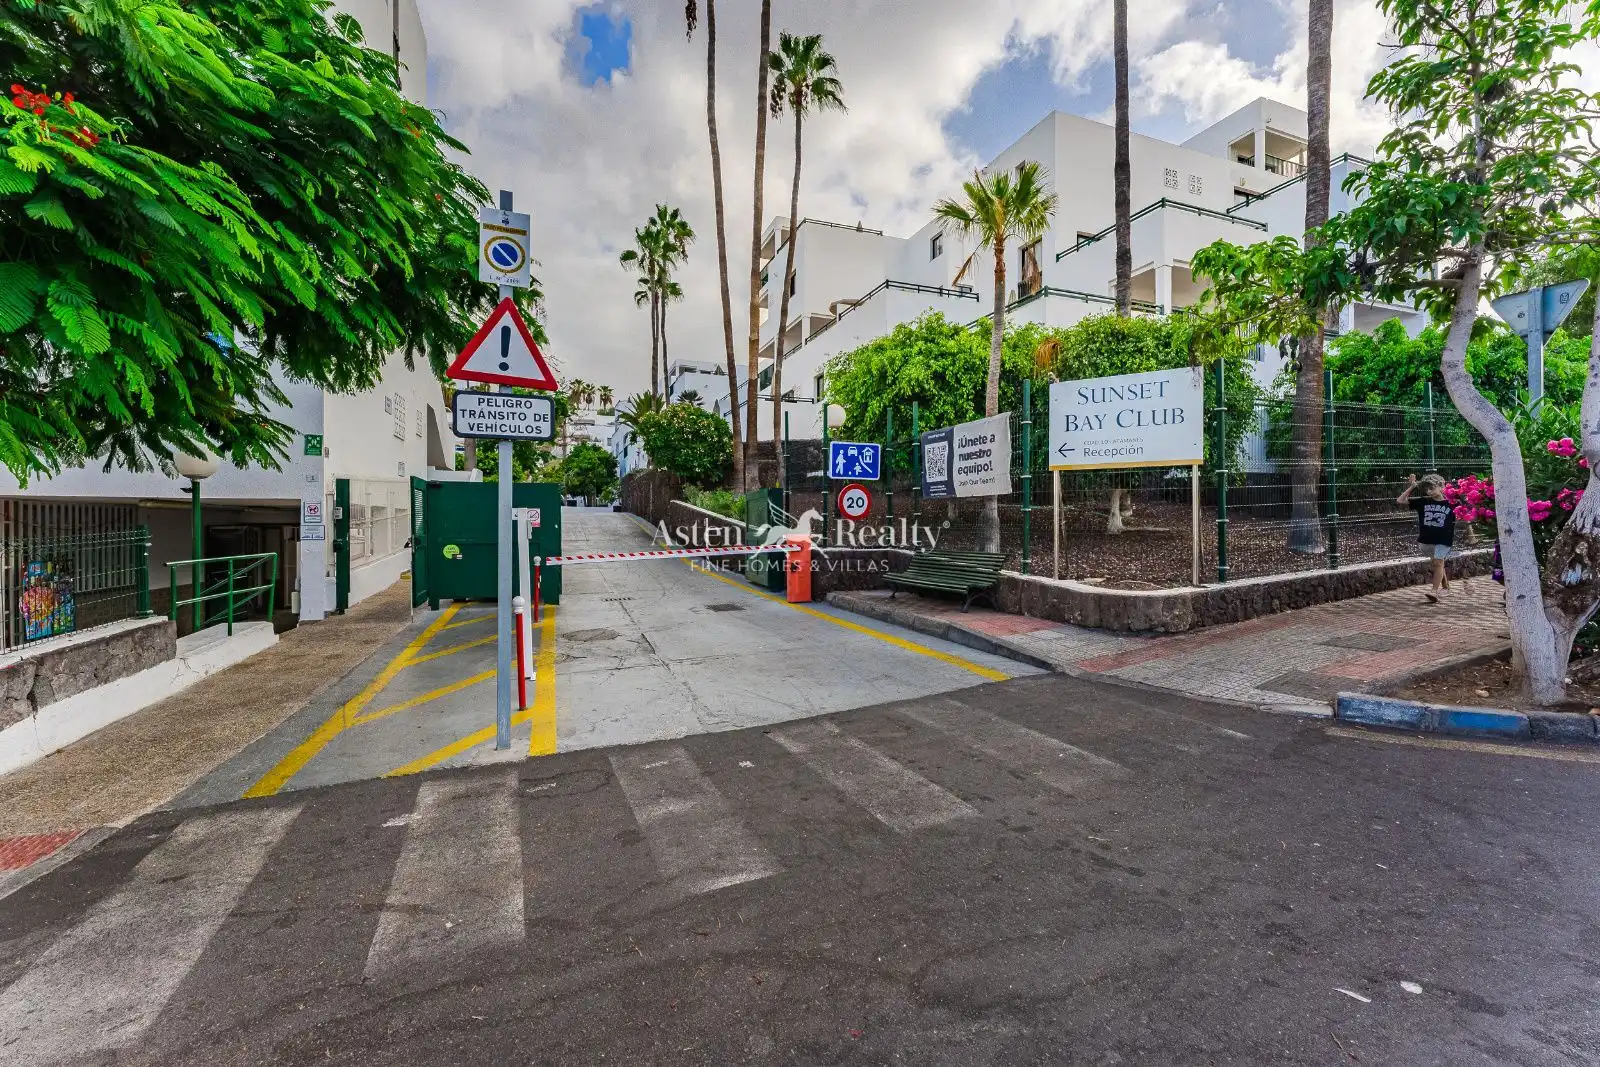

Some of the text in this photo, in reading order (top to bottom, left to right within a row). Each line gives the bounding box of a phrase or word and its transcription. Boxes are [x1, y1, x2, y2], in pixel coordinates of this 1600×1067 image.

[1077, 380, 1170, 405] SUNSET
[477, 397, 533, 409] PELIGRO
[459, 408, 549, 423] TRÁNSITO DE
[1064, 407, 1185, 432] BAY CLUB
[467, 421, 543, 434] VEHÍCULOS
[957, 434, 988, 448] ¡Únete
[989, 434, 996, 443] a
[958, 448, 992, 462] nuestro
[1083, 445, 1144, 458] Recepción
[957, 460, 993, 476] equipo!
[846, 497, 865, 509] 20
[1424, 512, 1446, 528] 23
